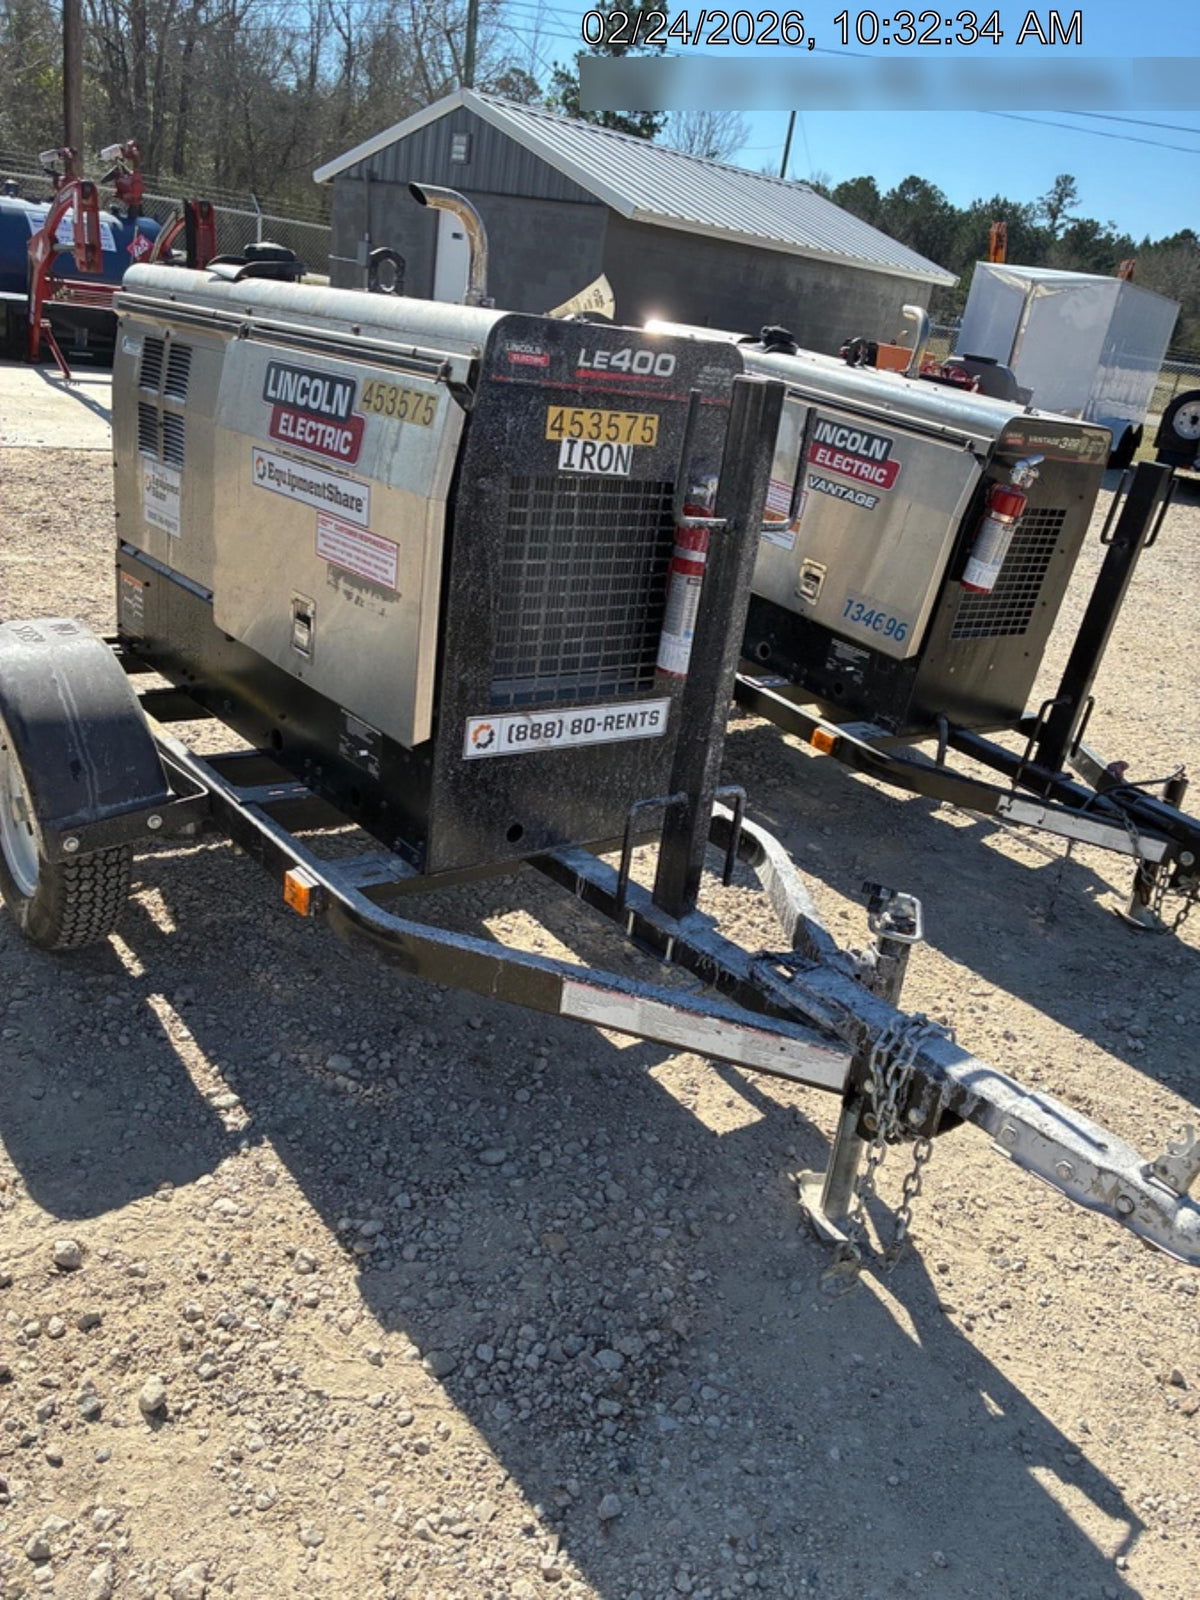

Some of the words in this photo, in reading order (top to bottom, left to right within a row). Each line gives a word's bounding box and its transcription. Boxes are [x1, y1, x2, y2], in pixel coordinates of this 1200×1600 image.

[577, 348, 677, 377] LE400
[266, 367, 351, 418] LINCOLN
[361, 382, 437, 426] 453575
[277, 412, 353, 455] ELECTRIC
[550, 409, 655, 444] 453575
[814, 422, 888, 461] INCOLN
[562, 440, 632, 473] IRON
[815, 448, 888, 484] ELECTRIC
[267, 461, 364, 514] EquipmentShare
[808, 475, 878, 509] VANTAGE
[842, 598, 909, 643] 134696
[507, 719, 564, 744] (888)
[570, 710, 660, 735] 80-RENTS
